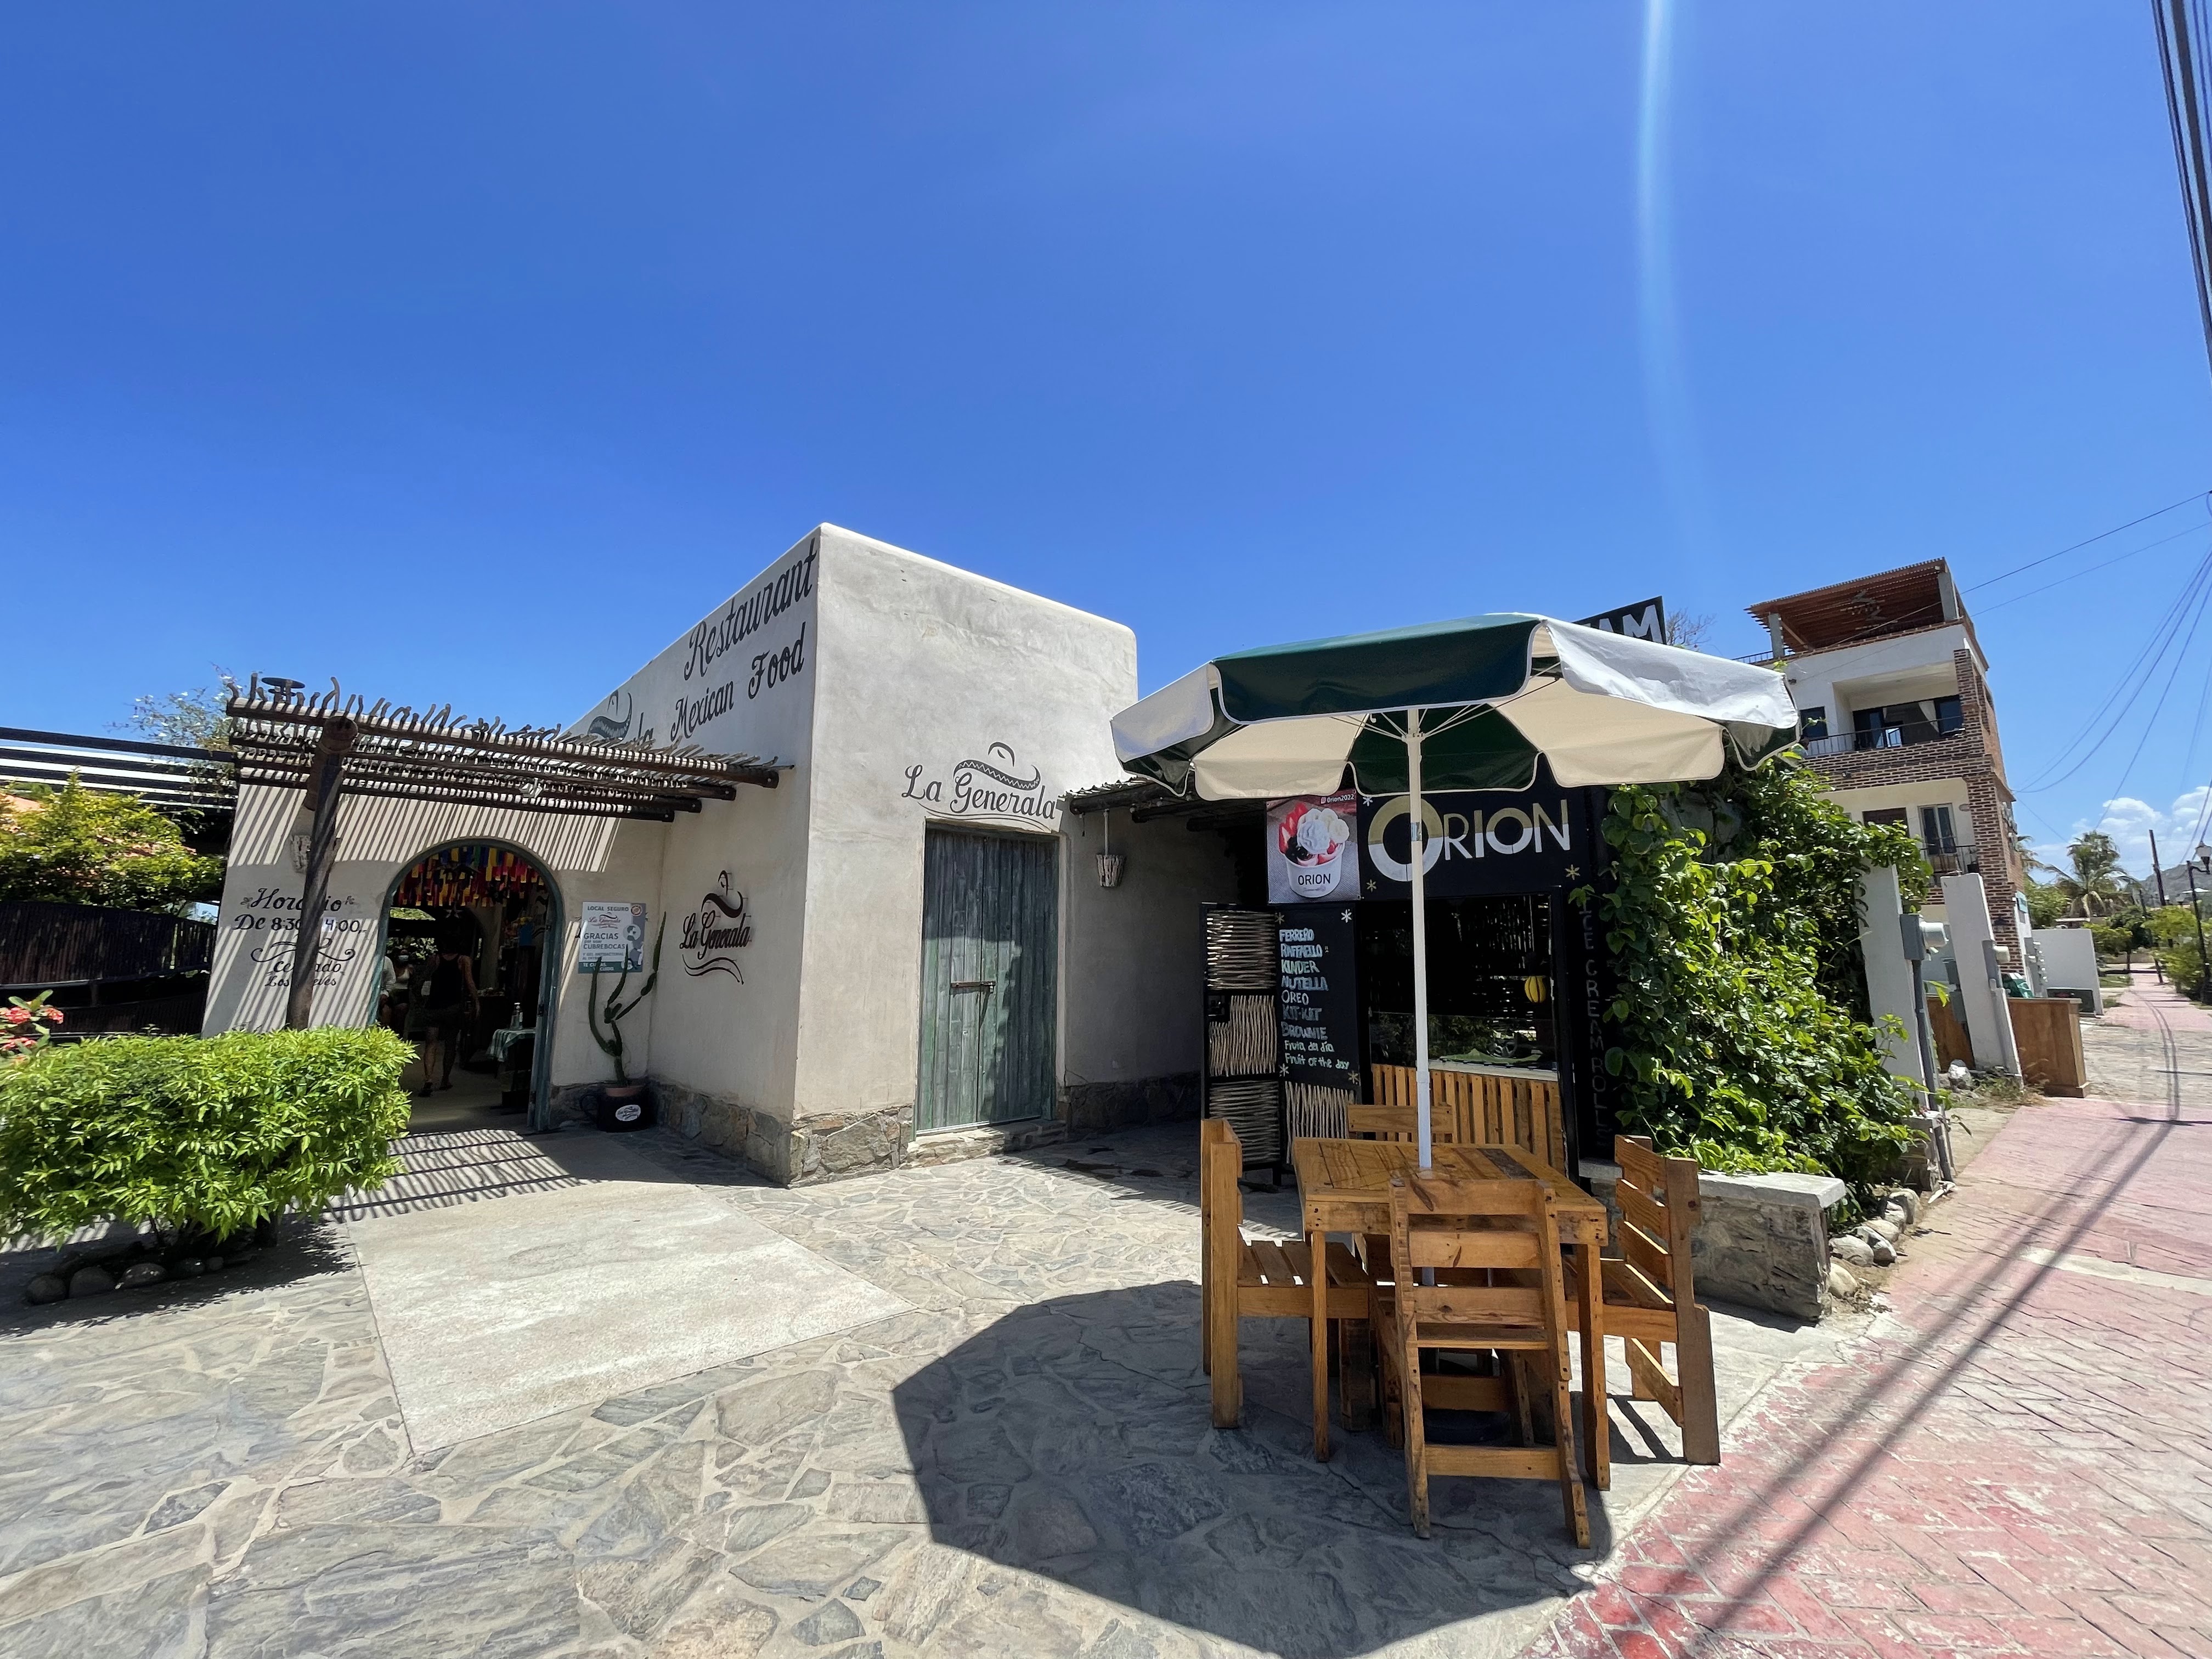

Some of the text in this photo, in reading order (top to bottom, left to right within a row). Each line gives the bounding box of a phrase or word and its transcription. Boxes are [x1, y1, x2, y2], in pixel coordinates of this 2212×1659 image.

[684, 537, 817, 681] Restaurant
[670, 681, 734, 742] Mexican
[748, 622, 806, 699] Food
[901, 764, 1057, 820] La Generala
[1368, 795, 1571, 882] ORION
[1298, 873, 1331, 885] ORION
[233, 914, 266, 930] De
[1579, 898, 1594, 950] ICE
[679, 910, 751, 960] La Generala
[1279, 928, 1314, 942] FERRERO
[1281, 960, 1320, 975] KINDER
[265, 975, 290, 987] Los
[1281, 975, 1329, 991] NUTELLA
[1281, 990, 1309, 1005] OREO
[1585, 959, 1605, 1052] CREAM
[1281, 1022, 1328, 1040] BROWNIE
[1285, 1053, 1306, 1065] Fruit
